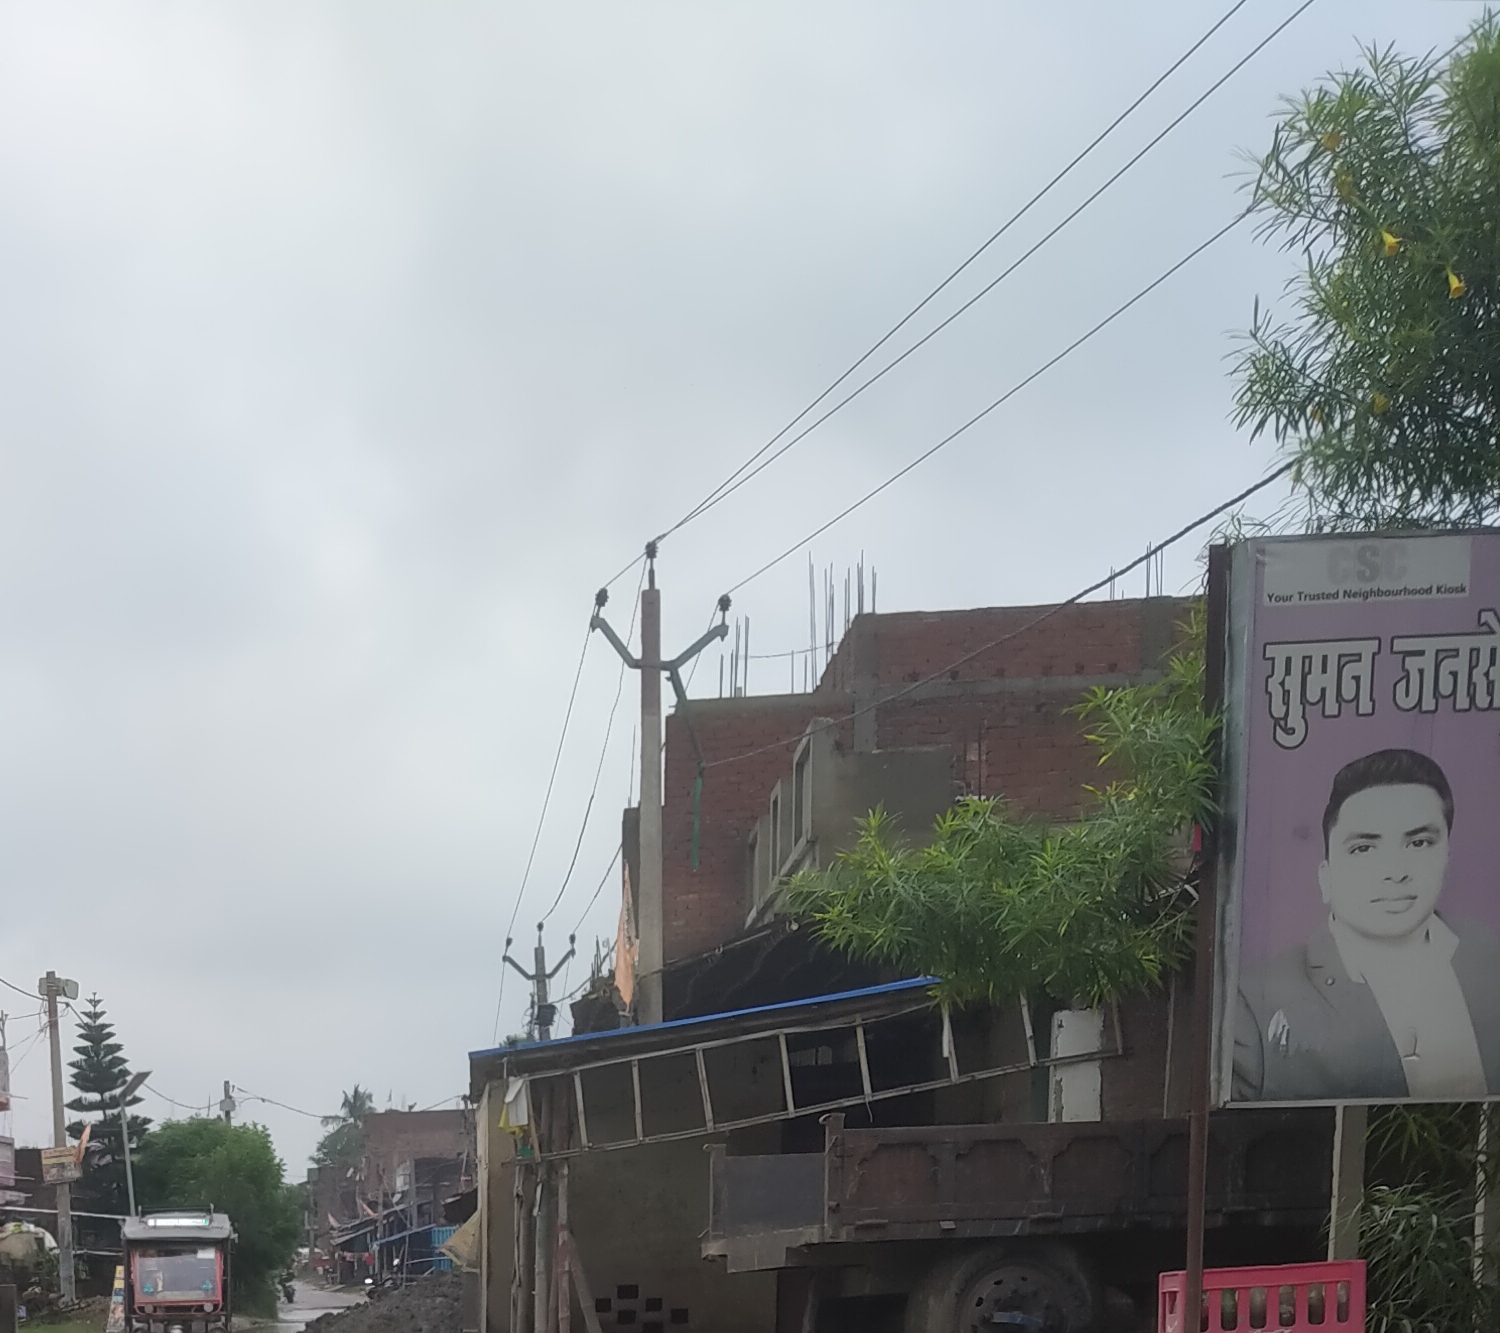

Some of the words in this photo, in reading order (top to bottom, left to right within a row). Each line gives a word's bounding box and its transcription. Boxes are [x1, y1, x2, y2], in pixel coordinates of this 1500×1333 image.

[1327, 544, 1408, 584] CSC
[1267, 592, 1294, 603] Your
[1297, 589, 1340, 602] Trusted
[1343, 584, 1434, 601] Neighbourhood
[1436, 582, 1467, 595] Kiosk
[1263, 636, 1381, 749] सुमन
